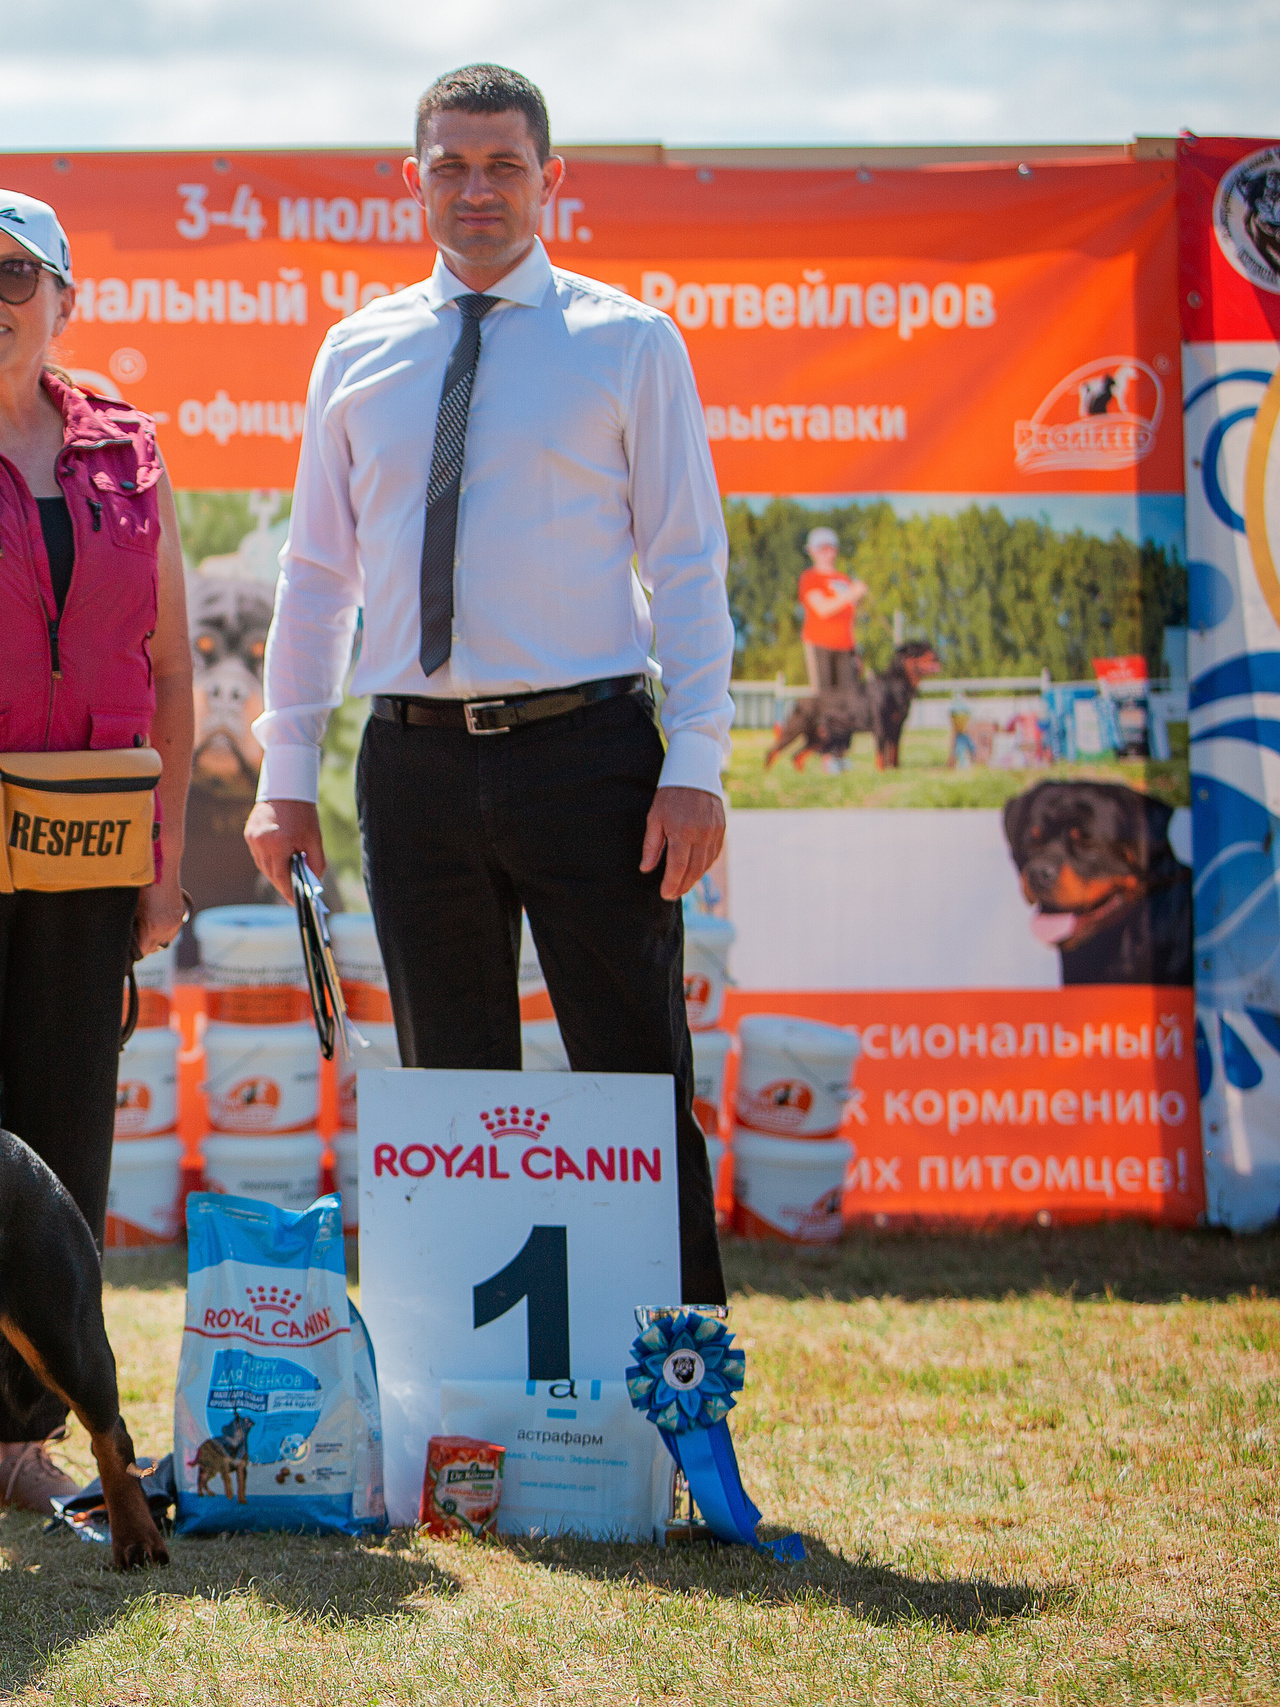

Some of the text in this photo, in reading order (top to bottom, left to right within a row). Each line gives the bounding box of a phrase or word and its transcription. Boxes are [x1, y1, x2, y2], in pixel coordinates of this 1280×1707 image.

[176, 183, 267, 241] 3-4
[278, 197, 422, 242] июля
[641, 269, 997, 340] Ротвейлеров
[705, 403, 908, 441] выставки
[8, 809, 132, 857] RESPECT
[883, 1089, 1187, 1136] кормлению
[373, 1143, 662, 1183] ROYAL CANIN
[918, 1147, 1189, 1200] питомцев!
[204, 1307, 331, 1339] ROYAL CANIN
[473, 1224, 571, 1380] 1
[516, 1429, 604, 1447] астрафарм
